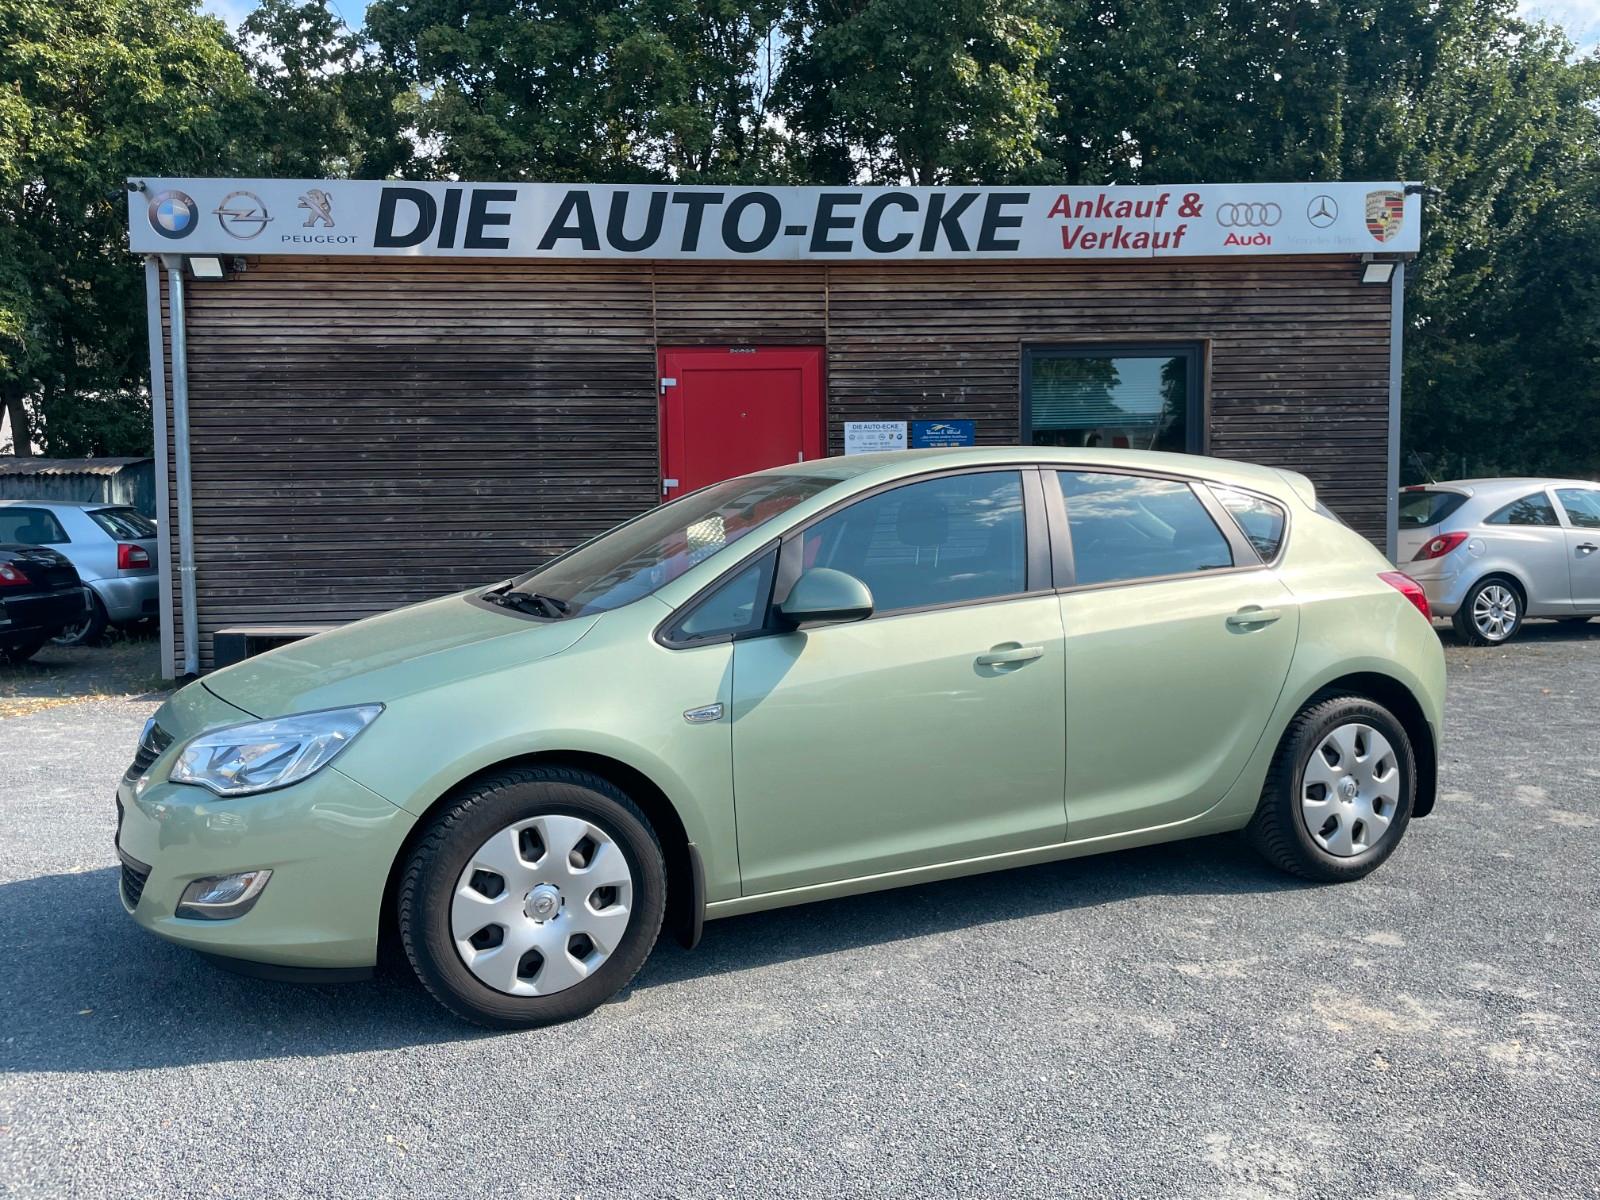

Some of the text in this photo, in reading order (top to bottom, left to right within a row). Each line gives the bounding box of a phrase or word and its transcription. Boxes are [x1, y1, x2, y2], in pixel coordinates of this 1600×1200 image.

[1047, 192, 1205, 219] Ankauf &
[373, 187, 1031, 253] DIE AUTO-ECKE
[281, 234, 358, 244] PEUGEOT
[1060, 224, 1188, 250] Verkauf
[1223, 232, 1272, 246] Audi
